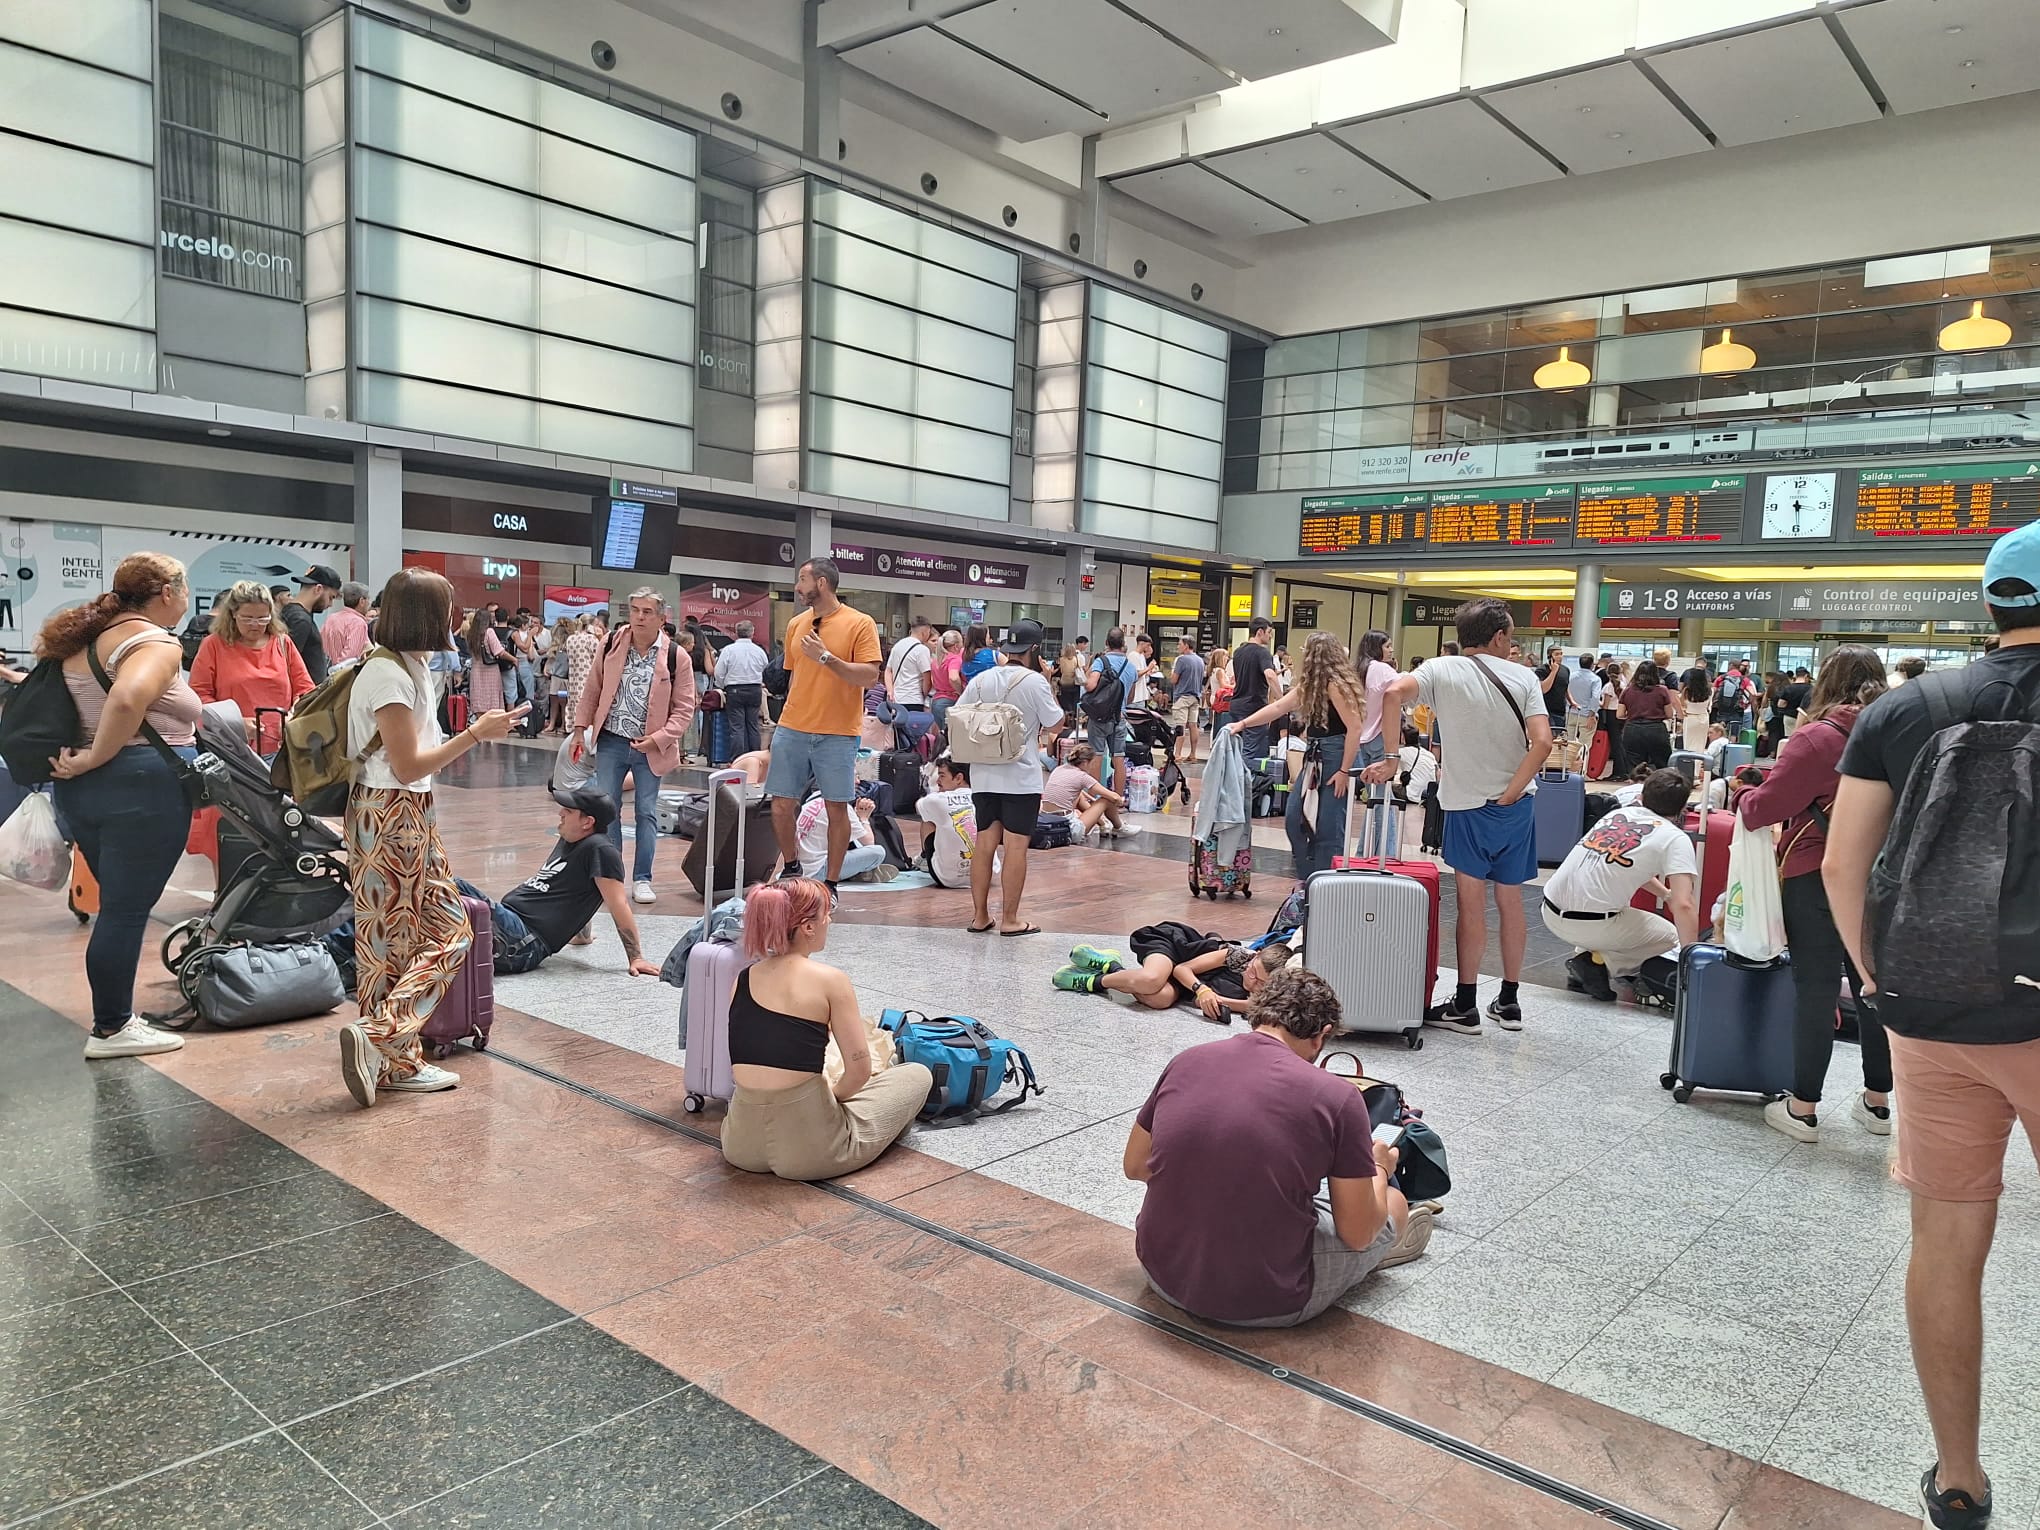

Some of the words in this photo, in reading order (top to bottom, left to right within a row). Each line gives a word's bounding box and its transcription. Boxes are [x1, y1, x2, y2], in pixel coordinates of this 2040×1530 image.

[1362, 459, 1376, 467] 912
[1378, 458, 1392, 466] 320
[1394, 456, 1408, 465] 320
[1424, 447, 1470, 466] renfe
[1457, 464, 1484, 476] AVE
[1582, 485, 1613, 494] Llegadas
[1433, 493, 1460, 502] Llegadas
[1304, 500, 1328, 508] Llegadas
[494, 513, 527, 531] CASA
[836, 548, 864, 561] billetes
[62, 557, 100, 568] INTELI
[895, 556, 925, 568] Atención
[926, 559, 934, 568] al
[935, 560, 958, 571] cliente
[62, 568, 102, 579] GENTE
[482, 558, 518, 580] iryo
[984, 565, 1020, 577] Información
[712, 583, 740, 604] iryo
[1643, 588, 1678, 611] 1-8
[1686, 589, 1728, 600] Acceso
[1733, 591, 1740, 600] a
[1745, 588, 1772, 600] vías
[1823, 588, 1874, 600] Control
[1880, 588, 1898, 600] de
[1903, 588, 1978, 603] equipajes
[1560, 605, 1572, 615] No
